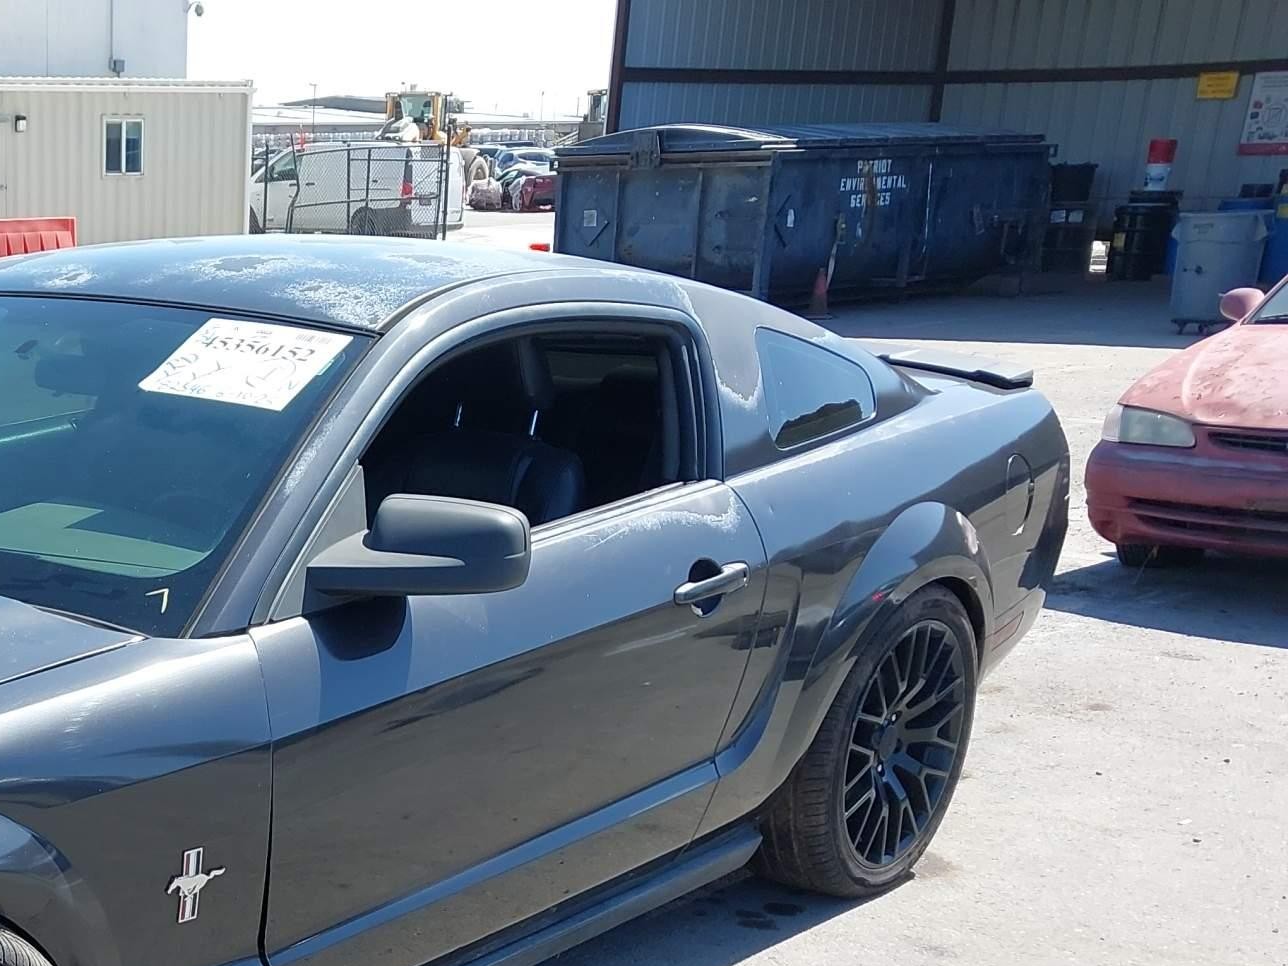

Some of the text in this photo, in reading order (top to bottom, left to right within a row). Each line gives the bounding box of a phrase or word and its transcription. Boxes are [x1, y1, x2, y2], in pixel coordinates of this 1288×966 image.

[840, 175, 906, 191] ENVIRMENTAL
[850, 193, 891, 207] SERCES
[201, 335, 316, 362] 45356152
